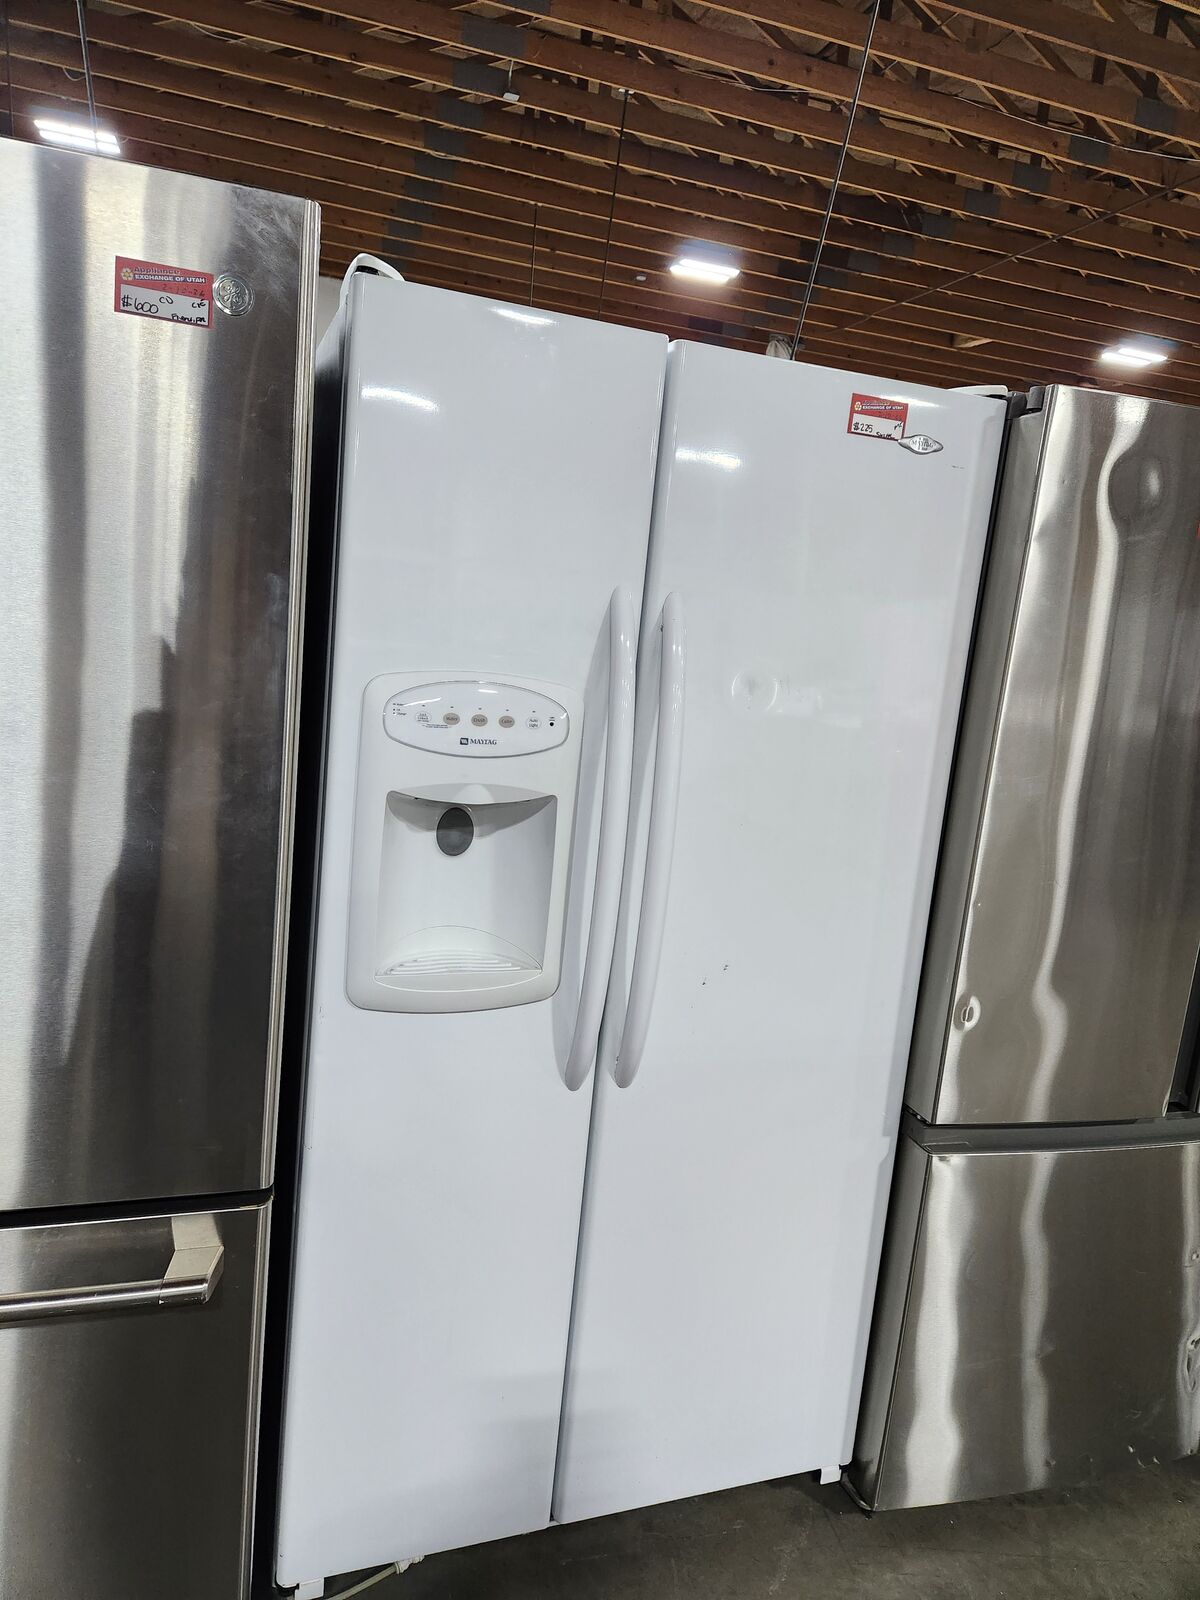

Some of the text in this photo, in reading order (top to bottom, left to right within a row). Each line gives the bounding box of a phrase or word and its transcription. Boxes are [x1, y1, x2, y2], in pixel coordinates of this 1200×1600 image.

[134, 273, 174, 281] EXCHANGE
[121, 294, 159, 314] $600
[853, 421, 874, 433] $225
[470, 738, 497, 746] MAYTAG
